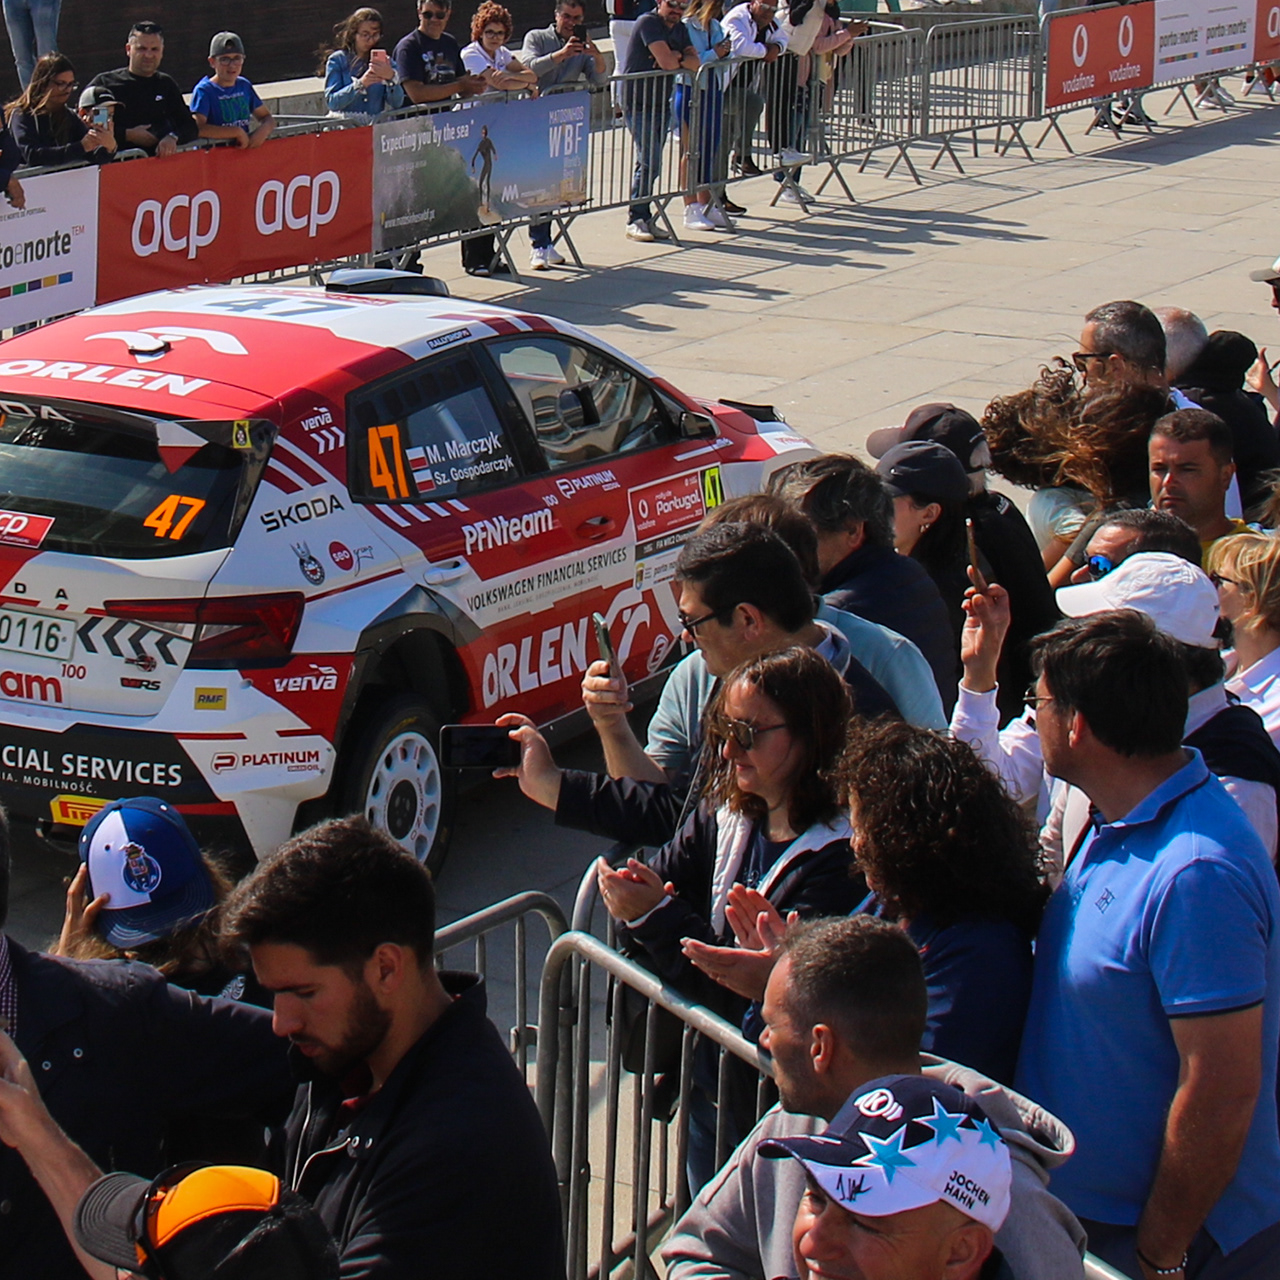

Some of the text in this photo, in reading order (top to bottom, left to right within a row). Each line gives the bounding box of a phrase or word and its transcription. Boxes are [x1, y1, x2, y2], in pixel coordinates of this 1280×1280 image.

[1062, 73, 1095, 94] vodafone
[1109, 63, 1141, 83] vodafone
[549, 106, 584, 122] MATOSINHOS
[381, 125, 469, 156] Expecting you by the sea
[549, 123, 584, 157] WBF
[255, 169, 341, 238] acp
[72, 225, 85, 236] TEM
[131, 188, 220, 260] acp
[301, 411, 333, 431] verva
[368, 424, 410, 500] 47
[426, 431, 502, 465] M. Marczyk
[434, 455, 515, 486] Sz. Gospodarczyk
[571, 470, 617, 490] PLATINUM
[541, 494, 560, 507] 100
[705, 467, 722, 508] 47
[656, 489, 701, 516] Portugal
[143, 494, 206, 540] 47
[462, 507, 554, 556] PFNteam
[332, 550, 350, 562] seo
[467, 546, 627, 613] VOLKSWAGEN FINANCIAL SERVICES
[62, 663, 87, 680] 100
[482, 616, 590, 709] ORLEN
[274, 672, 338, 693] verva
[197, 694, 224, 705] RMF
[61, 752, 183, 787] SERVICES
[242, 750, 320, 767] PLATINUM
[23, 775, 98, 794] MOBILNOŚĆ.
[944, 1182, 975, 1210] HAHN
[949, 1170, 990, 1206] JOCHEN
